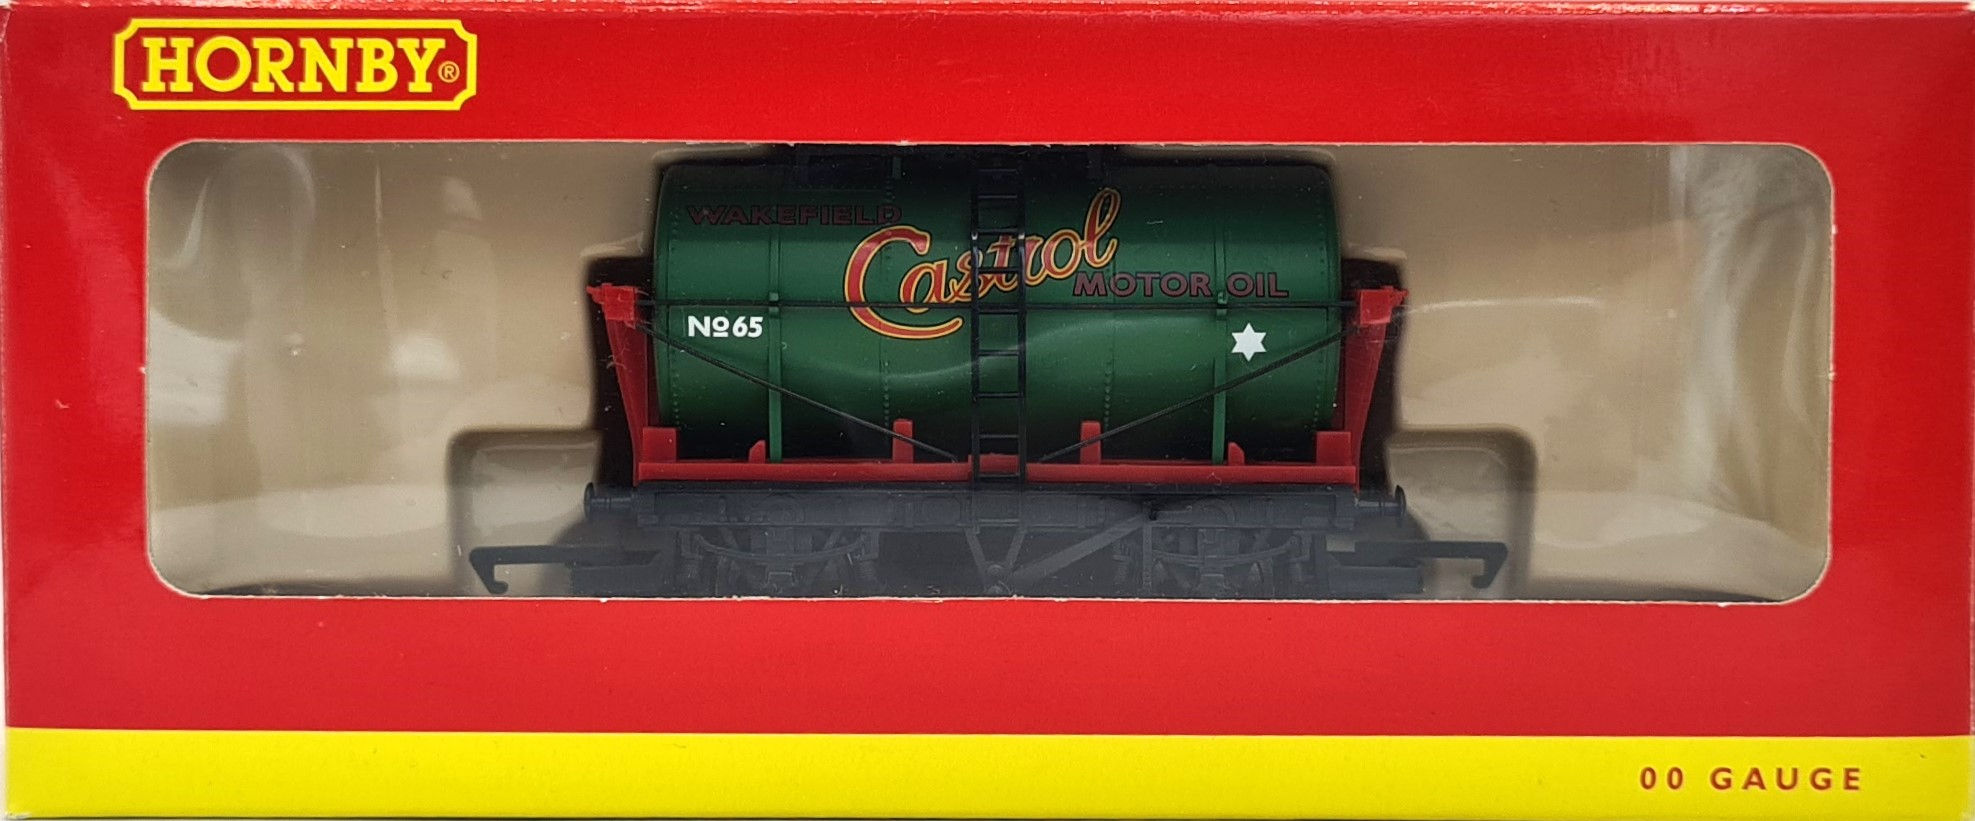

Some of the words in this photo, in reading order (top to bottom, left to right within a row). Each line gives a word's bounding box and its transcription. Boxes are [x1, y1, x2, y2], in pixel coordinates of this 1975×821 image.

[687, 204, 904, 226] WAKEFIELD
[844, 186, 1122, 340] Castrol
[1073, 271, 1213, 298] MOTOR
[1225, 272, 1289, 298] OIL
[1709, 767, 1861, 791] GAUGE
